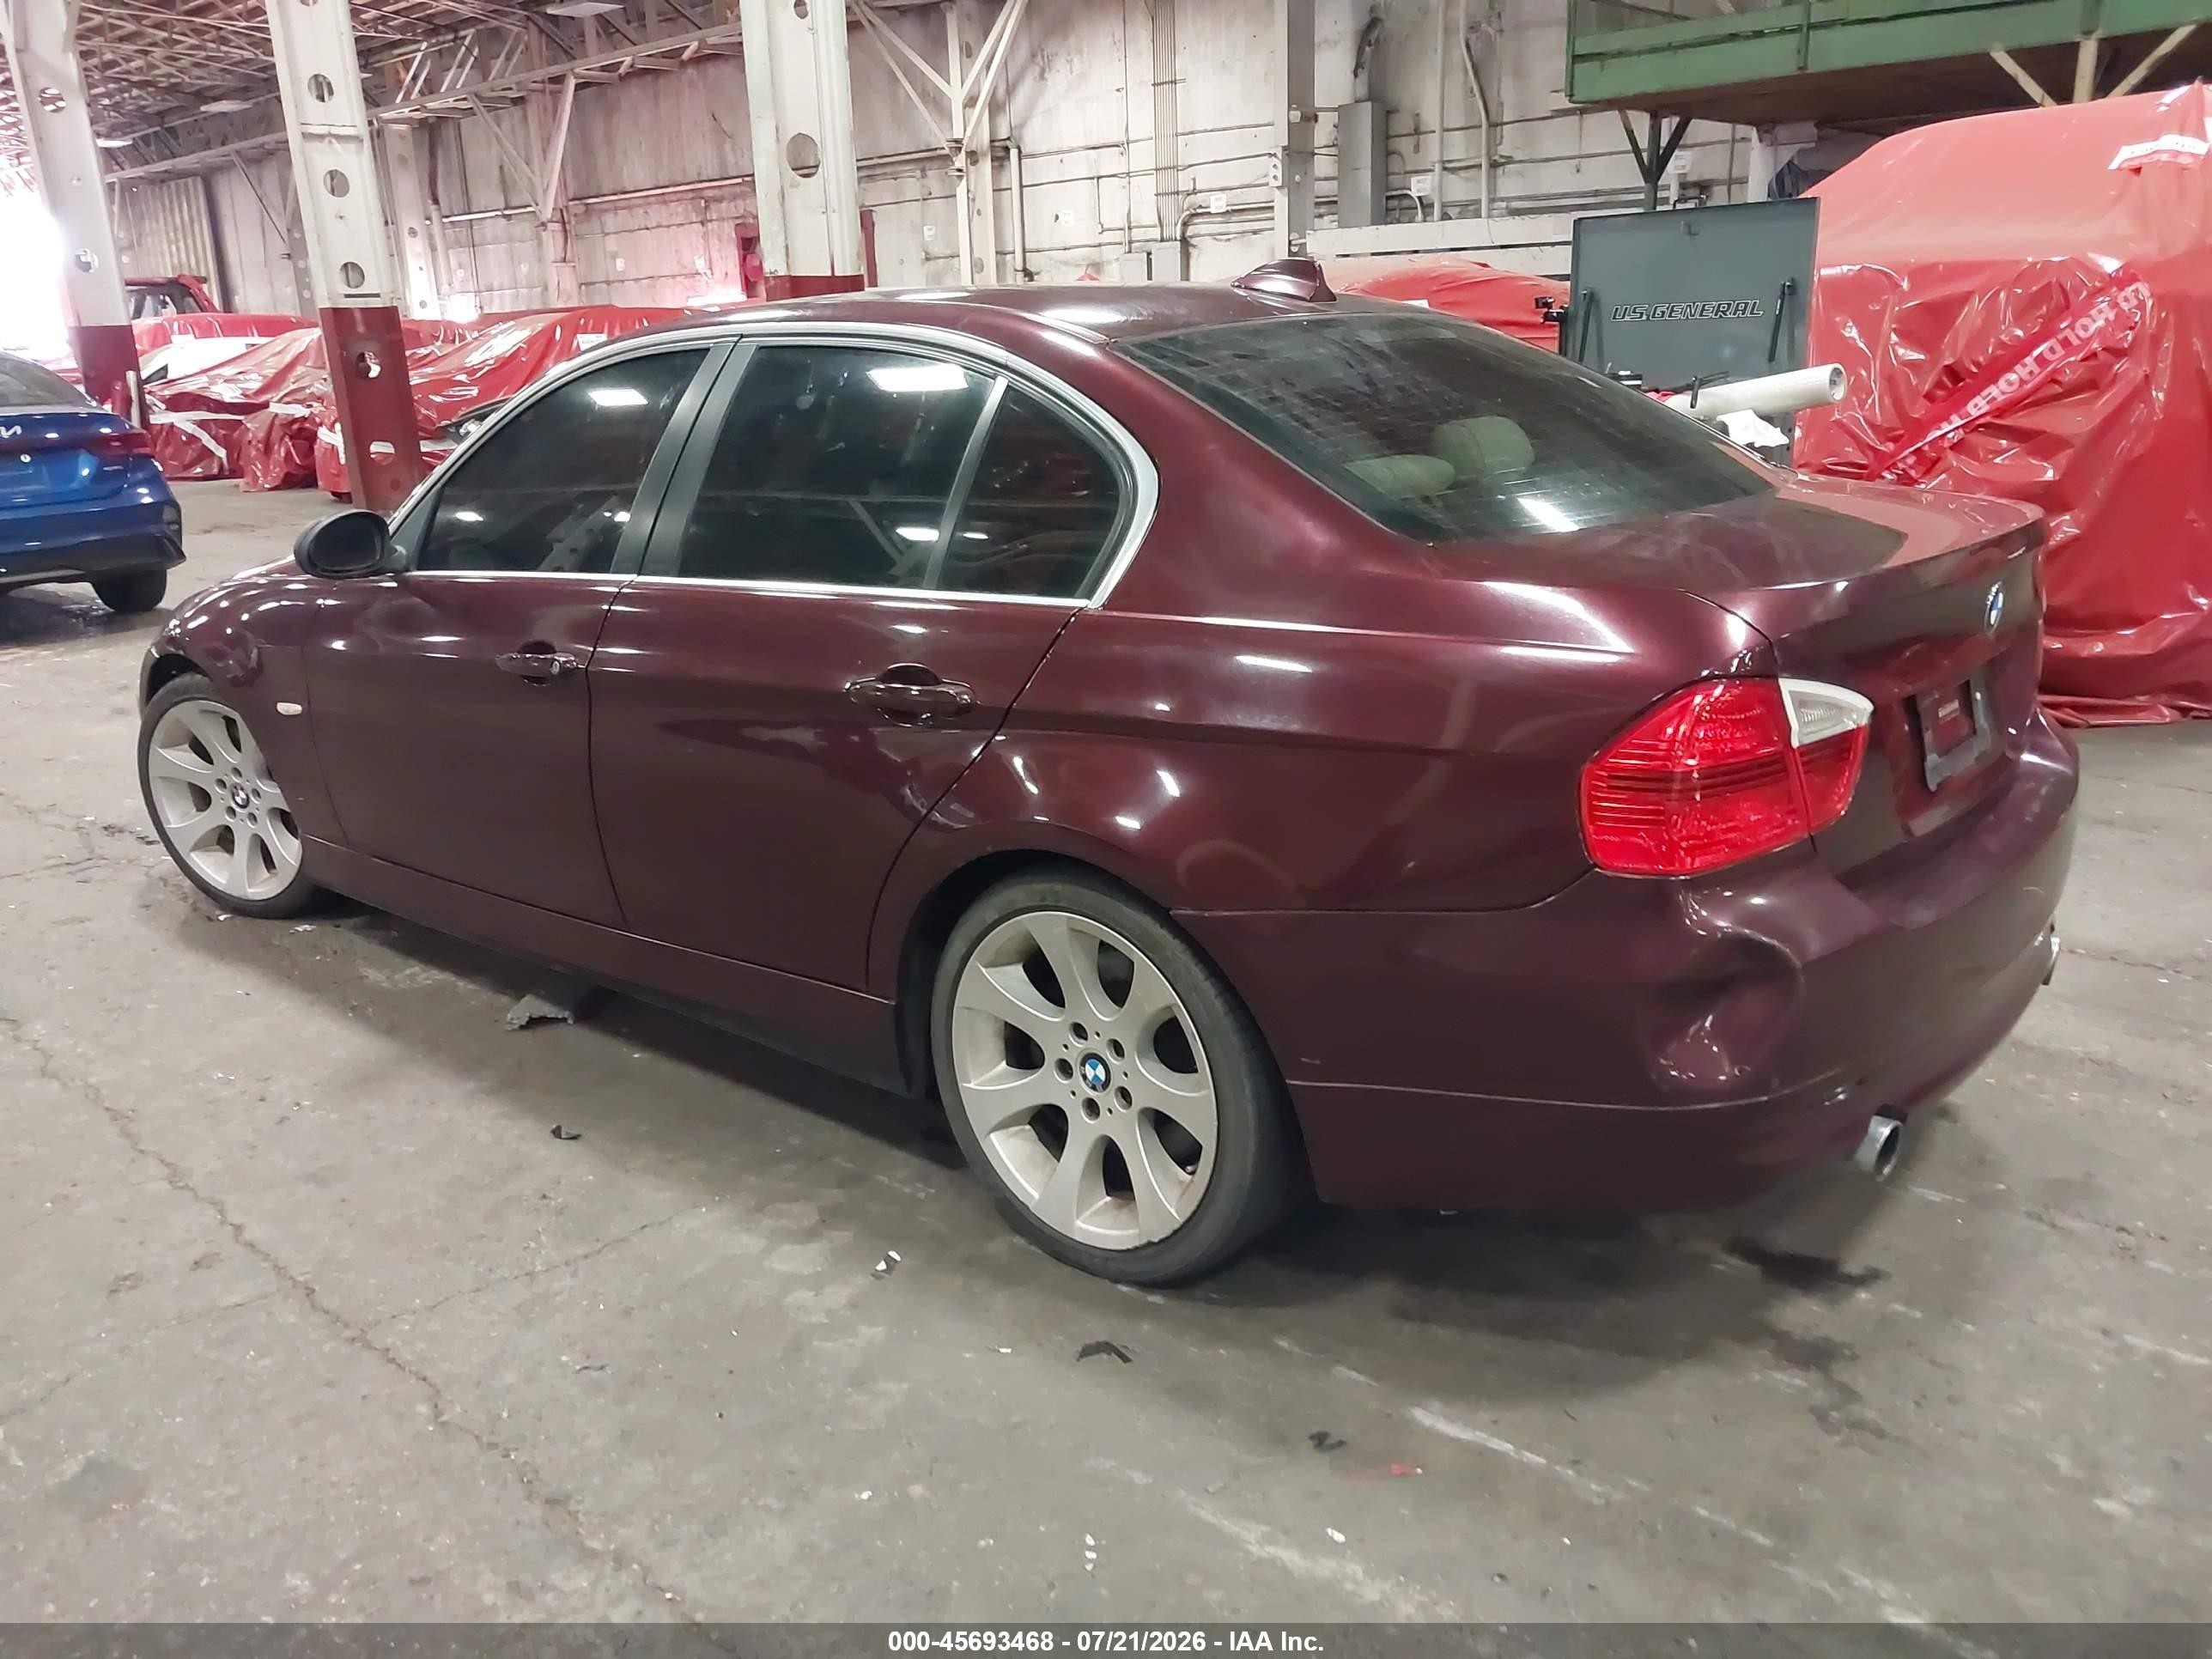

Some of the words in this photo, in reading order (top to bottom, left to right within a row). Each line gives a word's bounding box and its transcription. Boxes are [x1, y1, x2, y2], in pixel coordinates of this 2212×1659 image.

[1649, 300, 1765, 321] GENERAL
[2041, 301, 2117, 362] HOLD
[1966, 355, 2042, 416] HOLD
